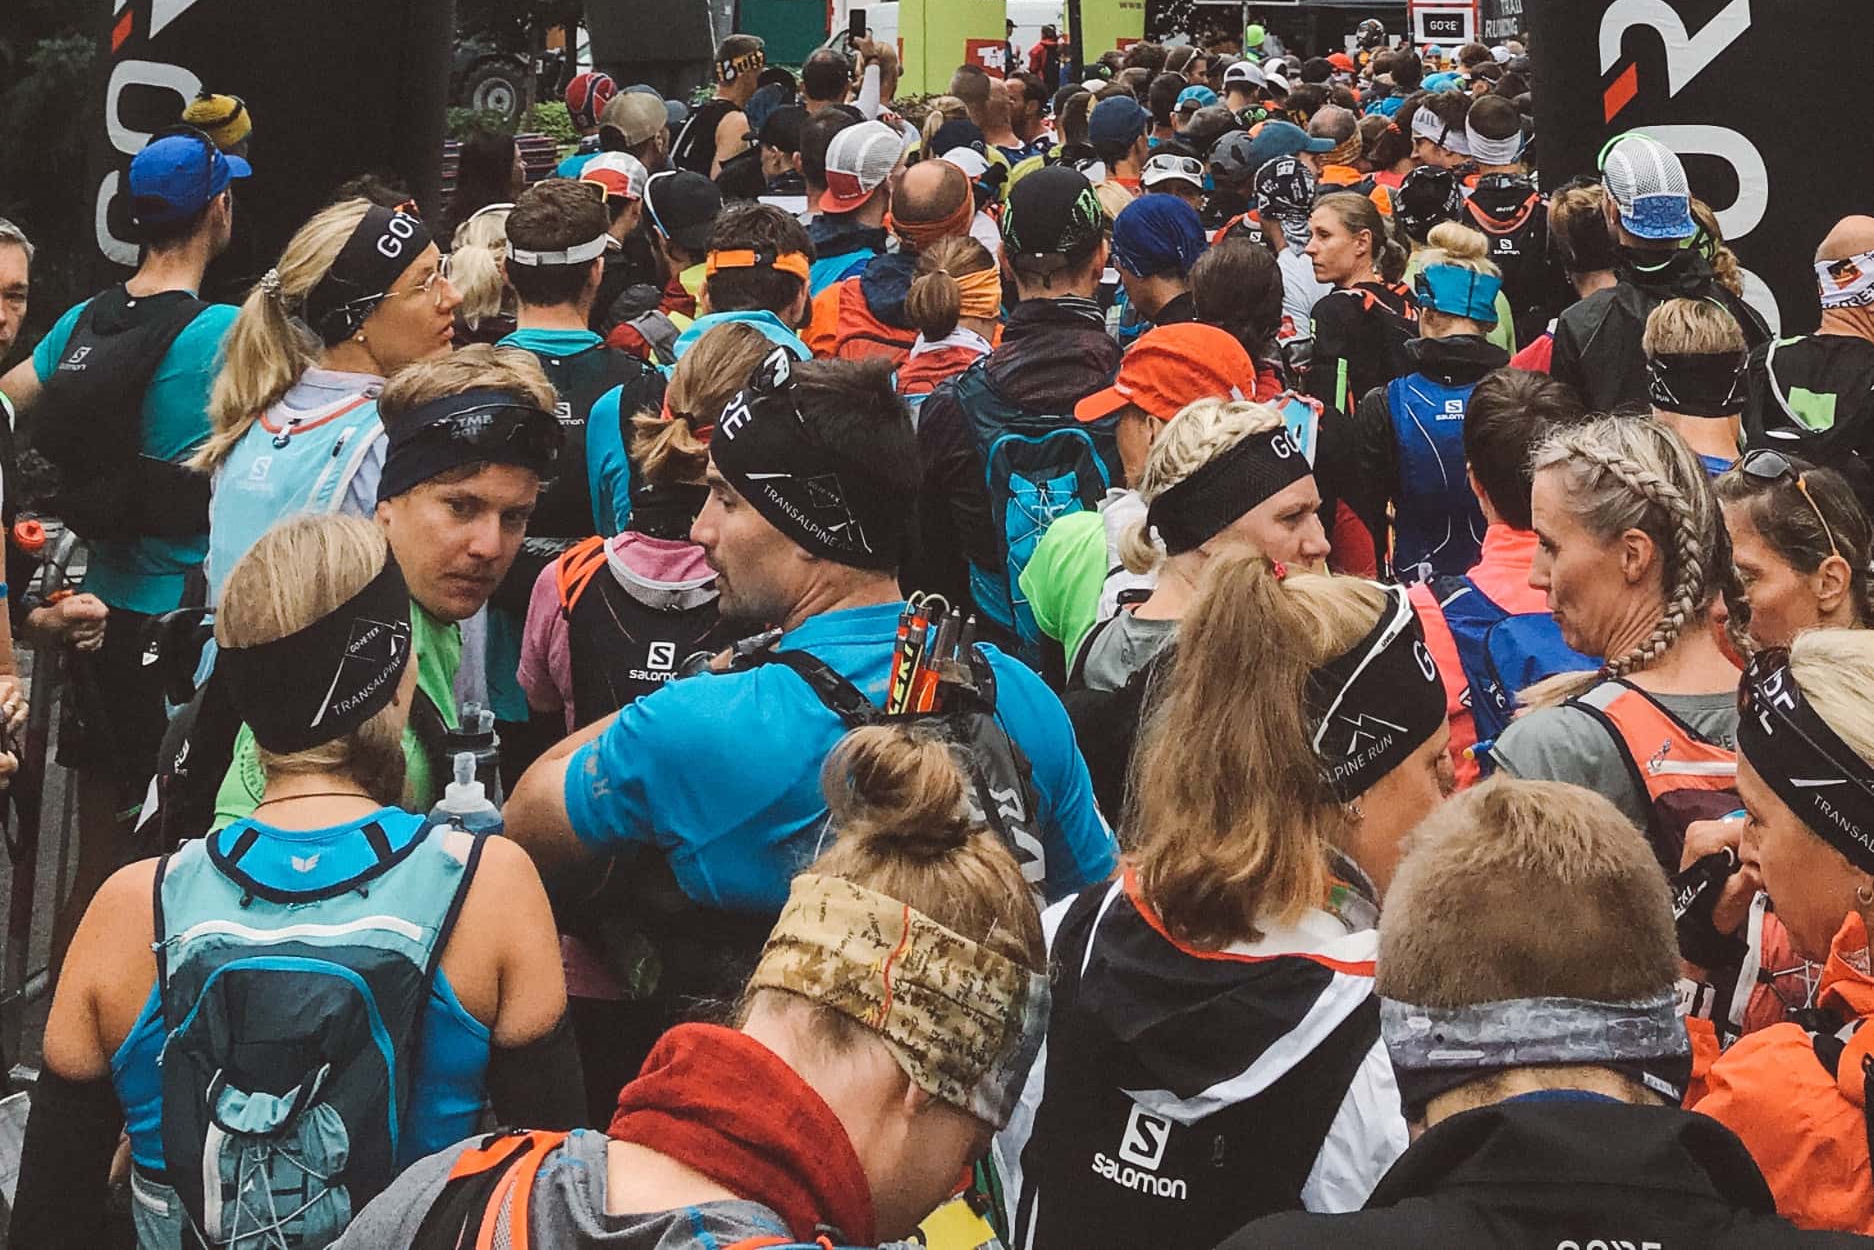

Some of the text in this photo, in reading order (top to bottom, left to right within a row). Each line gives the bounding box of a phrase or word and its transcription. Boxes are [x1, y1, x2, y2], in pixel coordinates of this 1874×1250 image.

[763, 483, 839, 547] TRANSALPINE
[1367, 734, 1394, 761] RUN
[1091, 1152, 1187, 1201] salomon
